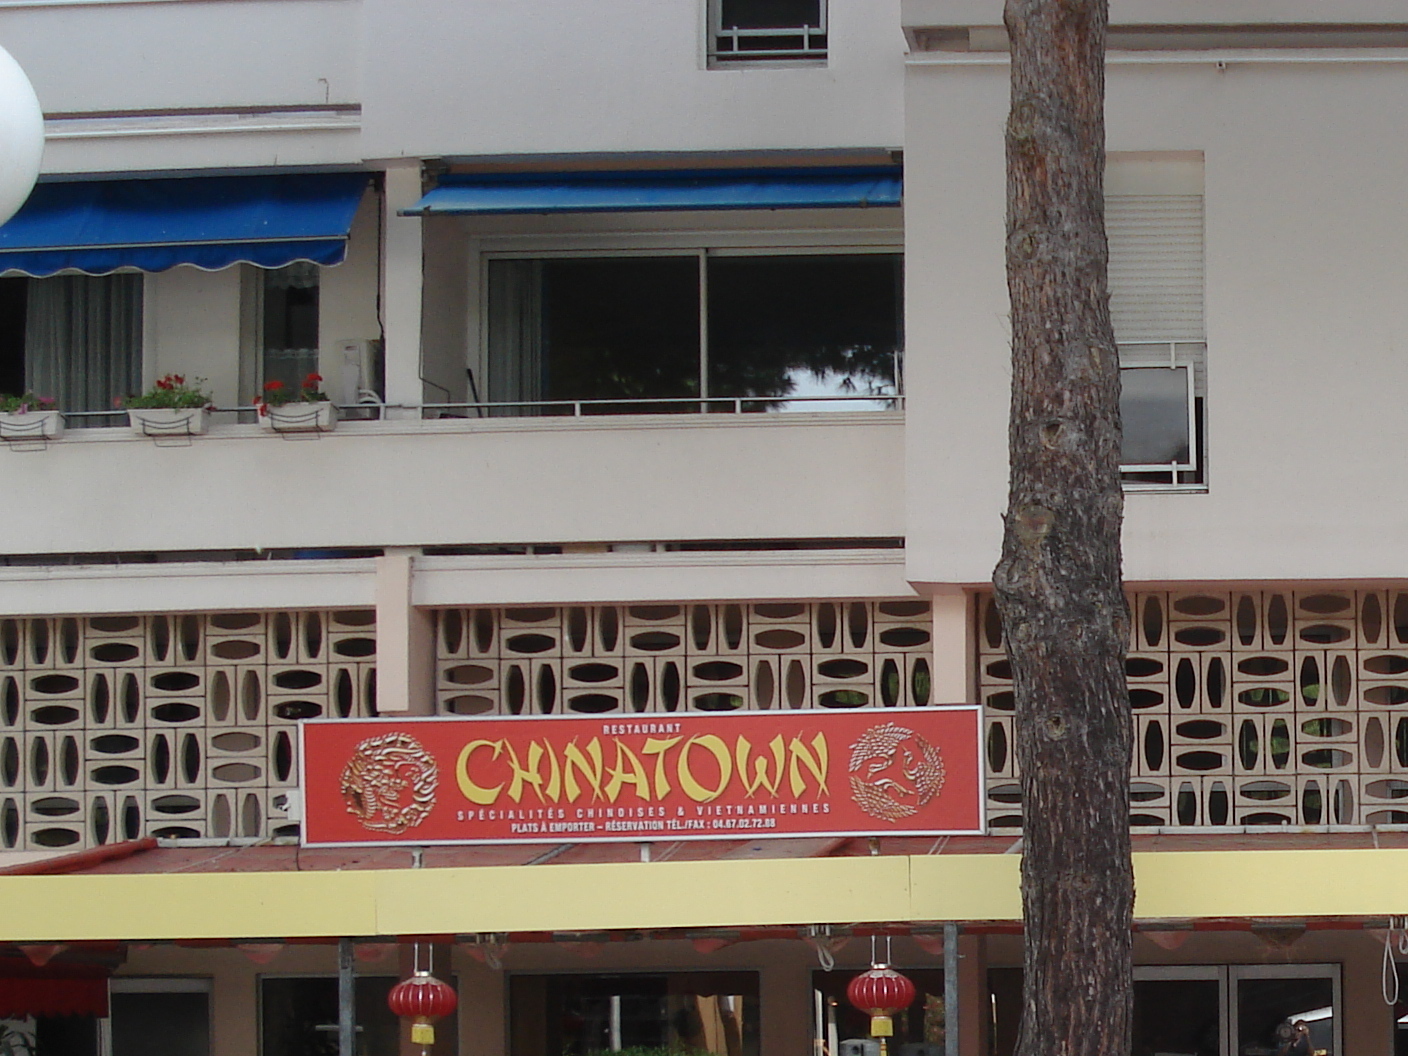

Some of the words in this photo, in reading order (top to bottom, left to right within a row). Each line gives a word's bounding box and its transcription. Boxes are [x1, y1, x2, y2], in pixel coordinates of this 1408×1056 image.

[602, 723, 682, 735] RESTAURANT
[456, 730, 830, 805] CHINATOWN
[457, 808, 566, 821] SPÉCIALITÉS
[576, 807, 665, 819] CHINOISES
[677, 806, 685, 817] &
[697, 803, 830, 817] VIETNAMIENNES
[511, 823, 538, 833] PLATS
[540, 821, 549, 833] À
[550, 822, 595, 833] EMPORTER
[605, 820, 664, 832] RÉSERVATION
